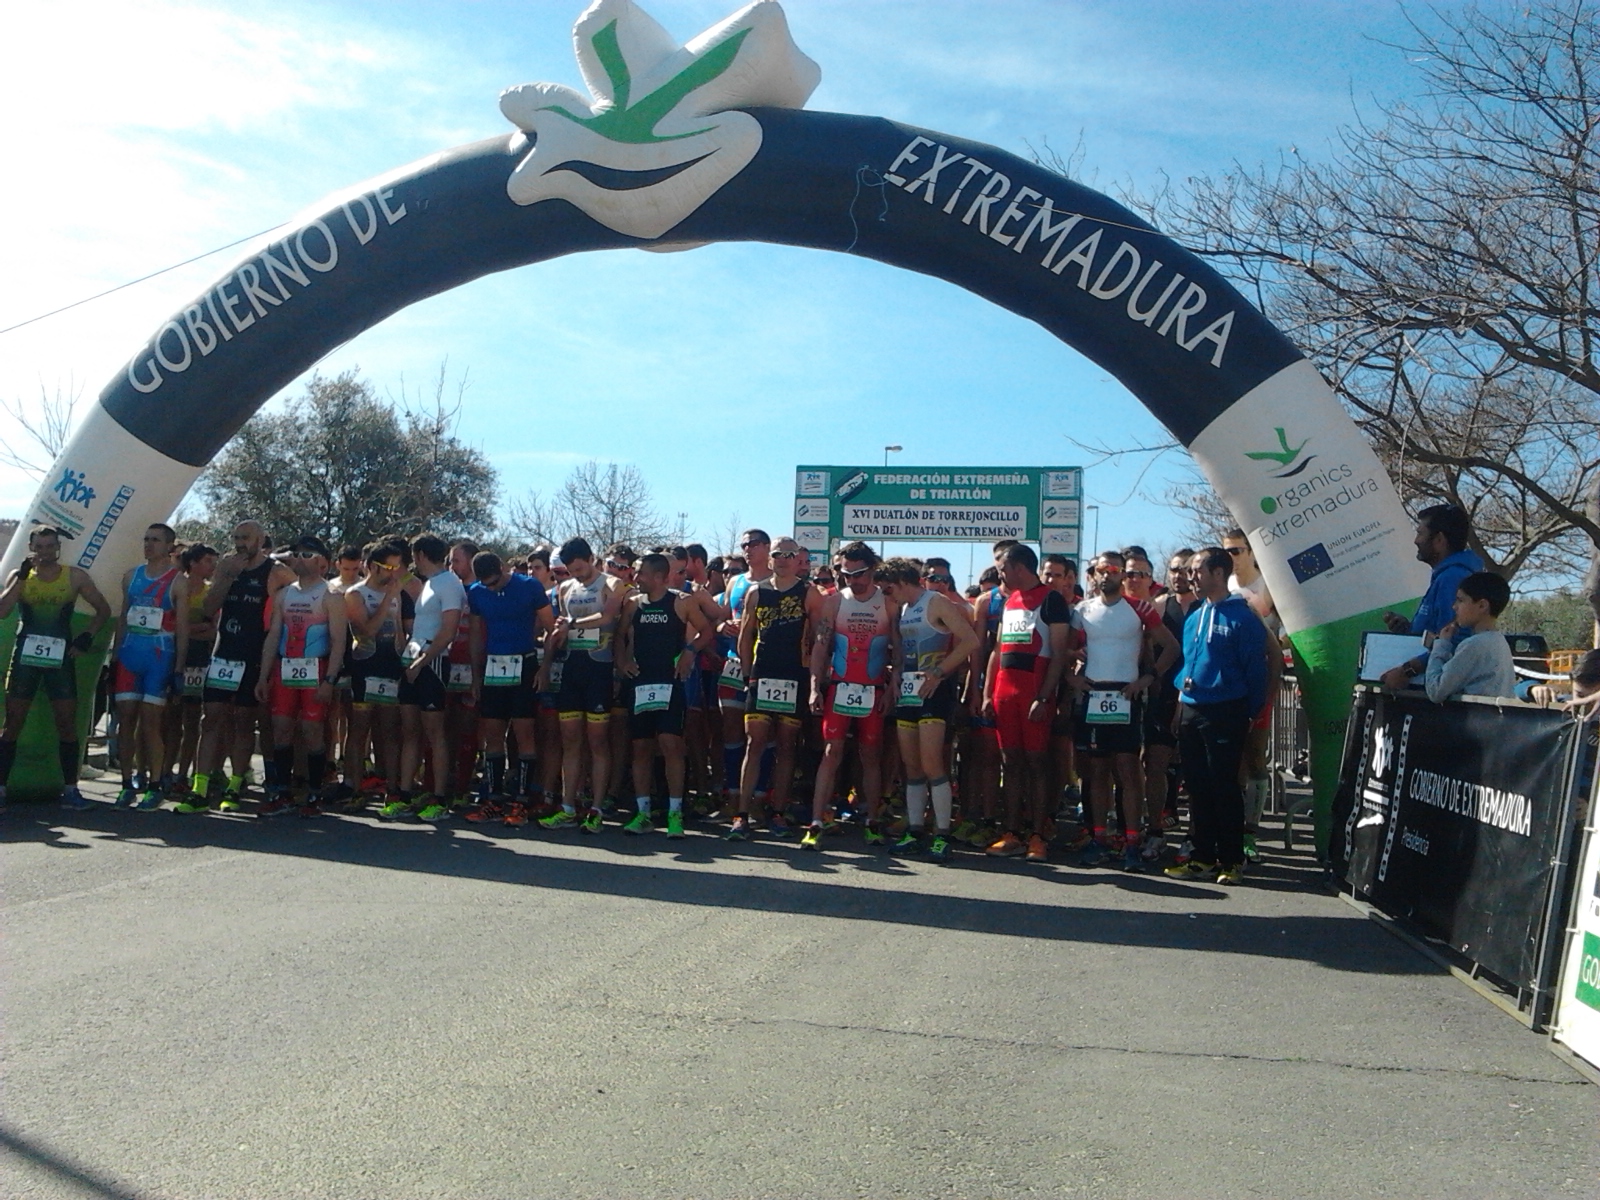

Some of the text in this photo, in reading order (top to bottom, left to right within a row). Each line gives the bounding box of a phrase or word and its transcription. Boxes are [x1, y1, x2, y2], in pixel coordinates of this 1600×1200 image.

[884, 135, 1236, 369] EXTREMADURA
[128, 188, 408, 394] GOBIERNO DE
[873, 471, 1030, 486] FEDERACIÓN EXTREMEÑA
[909, 486, 992, 500] DE TRIATLÓN
[852, 508, 1020, 524] XVI DUATLÓN DE TORREJONCILLO
[1258, 478, 1380, 547] Extremadura
[882, 525, 902, 535] DEL
[904, 524, 951, 536] DUATLÓN
[1326, 533, 1352, 550] UNION
[1353, 520, 1381, 539] EUROPEA
[139, 614, 148, 627] 3
[639, 613, 669, 624] MORENO
[577, 627, 586, 639] 2
[1008, 620, 1028, 632] 103
[34, 643, 52, 657] 51
[218, 666, 234, 680] 64
[292, 666, 308, 680] 26
[377, 682, 387, 694] 5
[765, 687, 789, 702] 121
[846, 694, 863, 707] 54
[1100, 700, 1118, 713] 66
[1409, 767, 1533, 838] GOBIERNO DE EXTREMADURA
